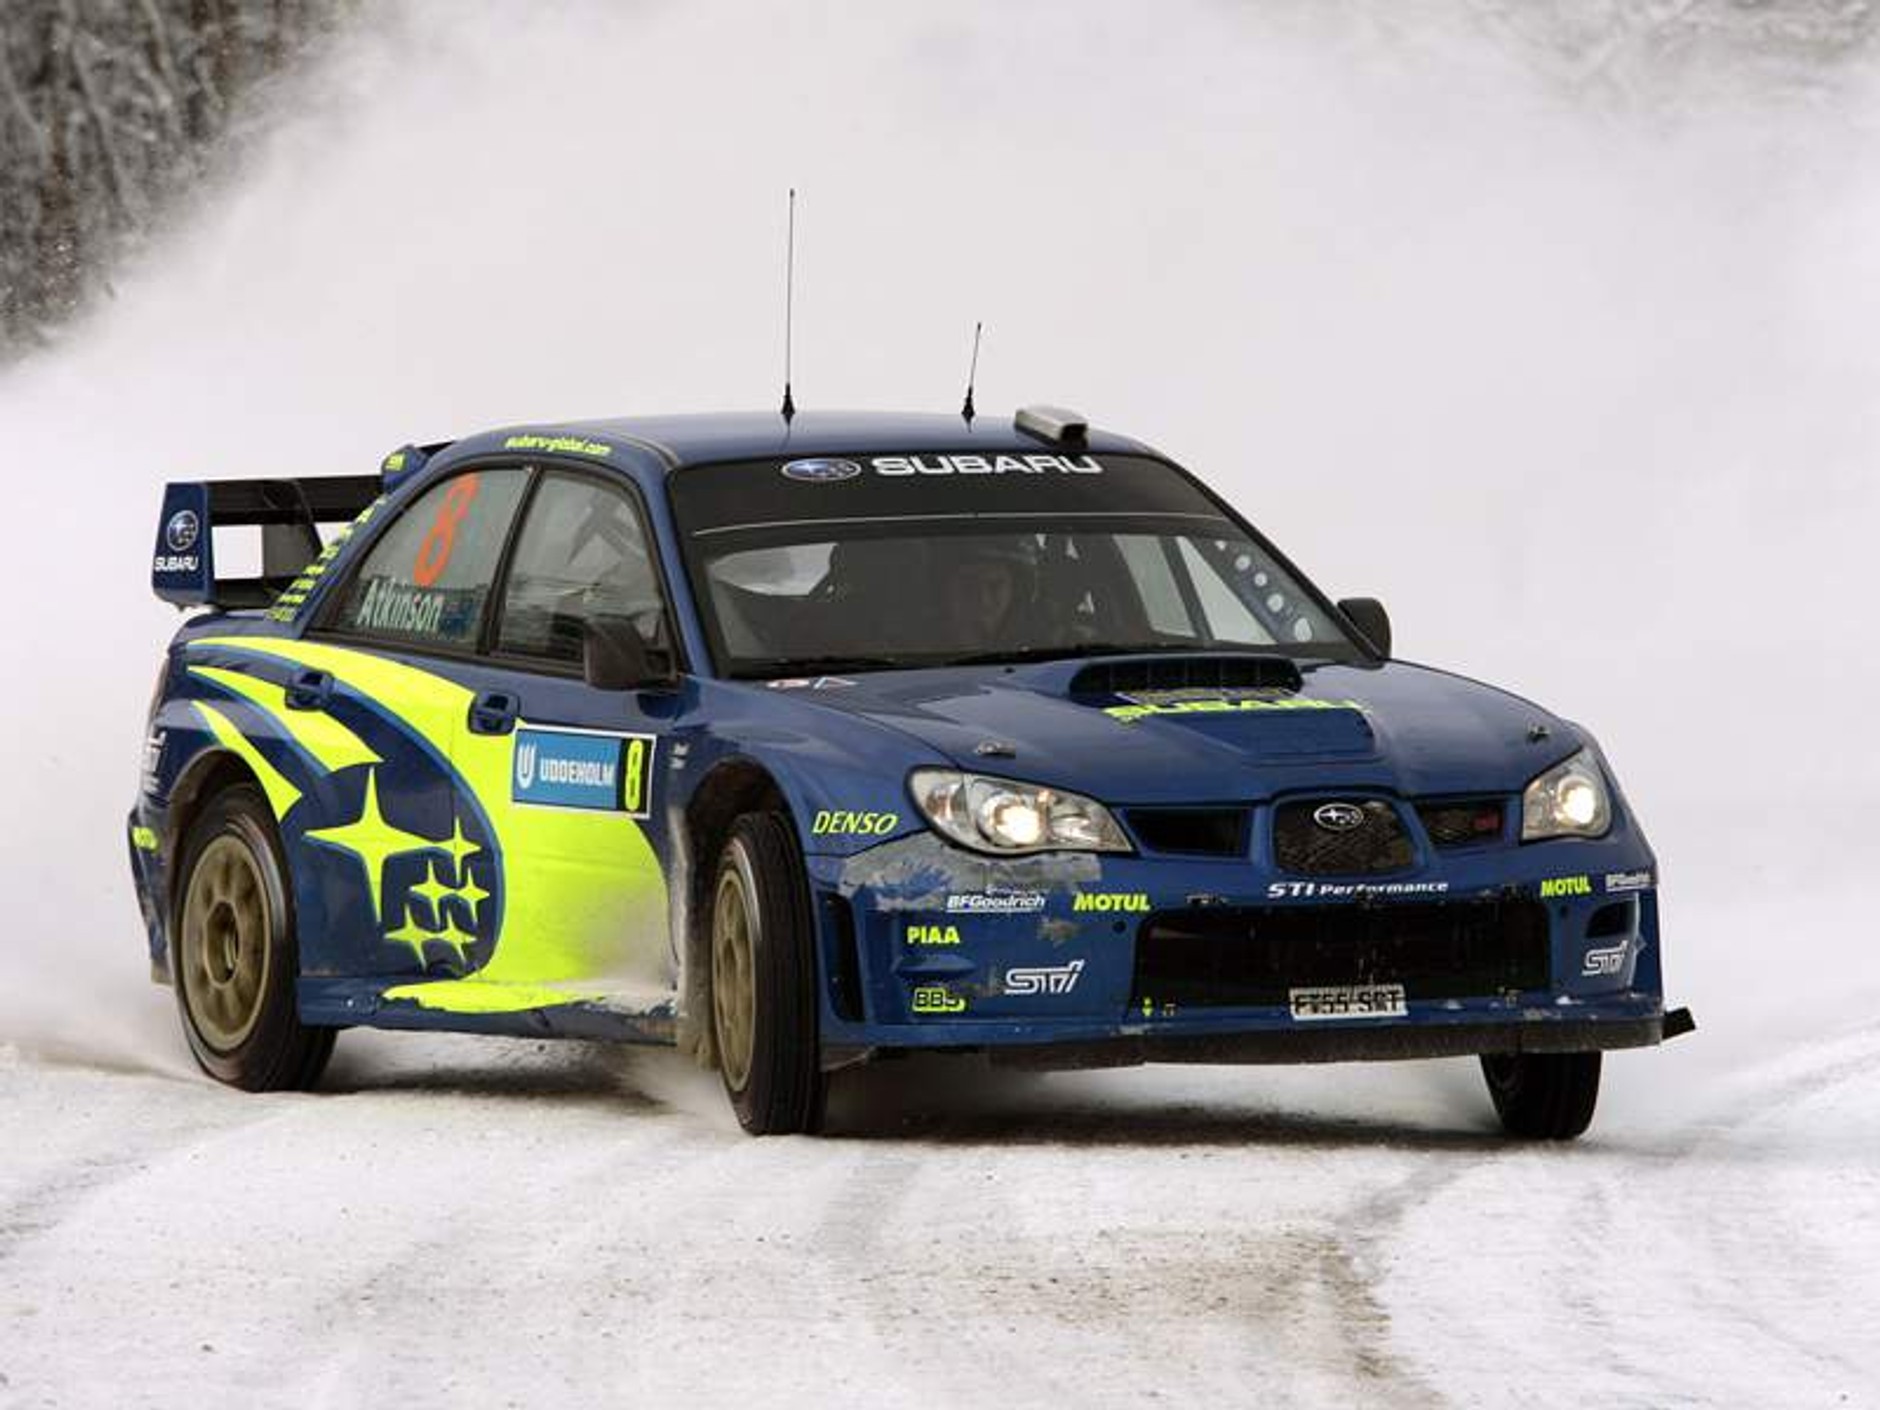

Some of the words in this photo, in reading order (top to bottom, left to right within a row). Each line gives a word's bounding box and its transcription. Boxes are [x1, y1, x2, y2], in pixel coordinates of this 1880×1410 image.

[871, 454, 1104, 477] SUBARU
[412, 472, 480, 588] 8
[153, 555, 199, 573] SUBARU
[356, 576, 446, 633] Atkinson
[539, 757, 615, 788] UDDEHOLM
[625, 738, 645, 813] 8
[812, 810, 898, 836] DENSO
[1266, 881, 1316, 899] STI
[1319, 881, 1449, 897] Performance
[1541, 874, 1592, 897] MOTUL
[946, 894, 1047, 914] BFGoodrich
[1072, 892, 1151, 912] MOTUL
[906, 925, 961, 945] PIAA
